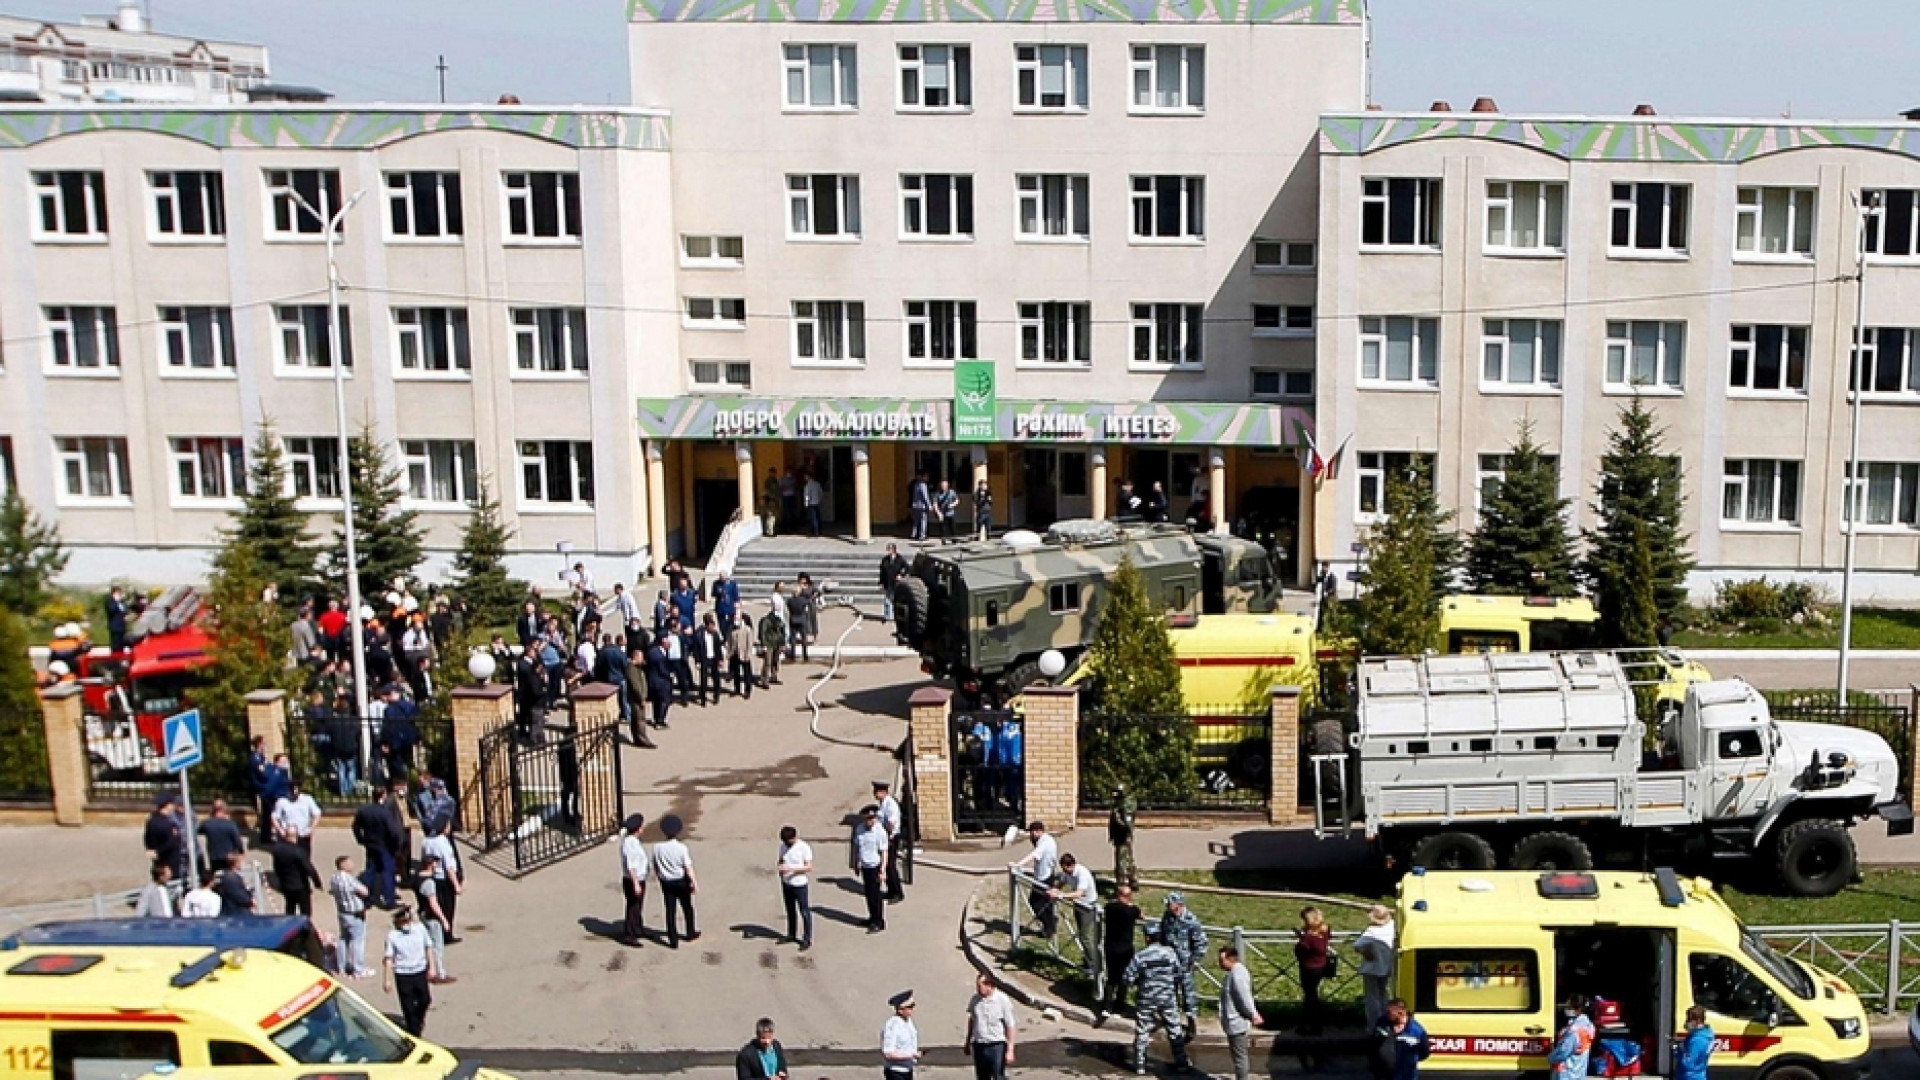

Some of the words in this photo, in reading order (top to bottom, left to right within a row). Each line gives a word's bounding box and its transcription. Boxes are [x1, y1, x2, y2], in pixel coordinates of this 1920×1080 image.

[714, 410, 782, 434] ДОБРО
[796, 411, 937, 434] ПОЖАЛОВАТЬ
[3, 1045, 51, 1071] 112
